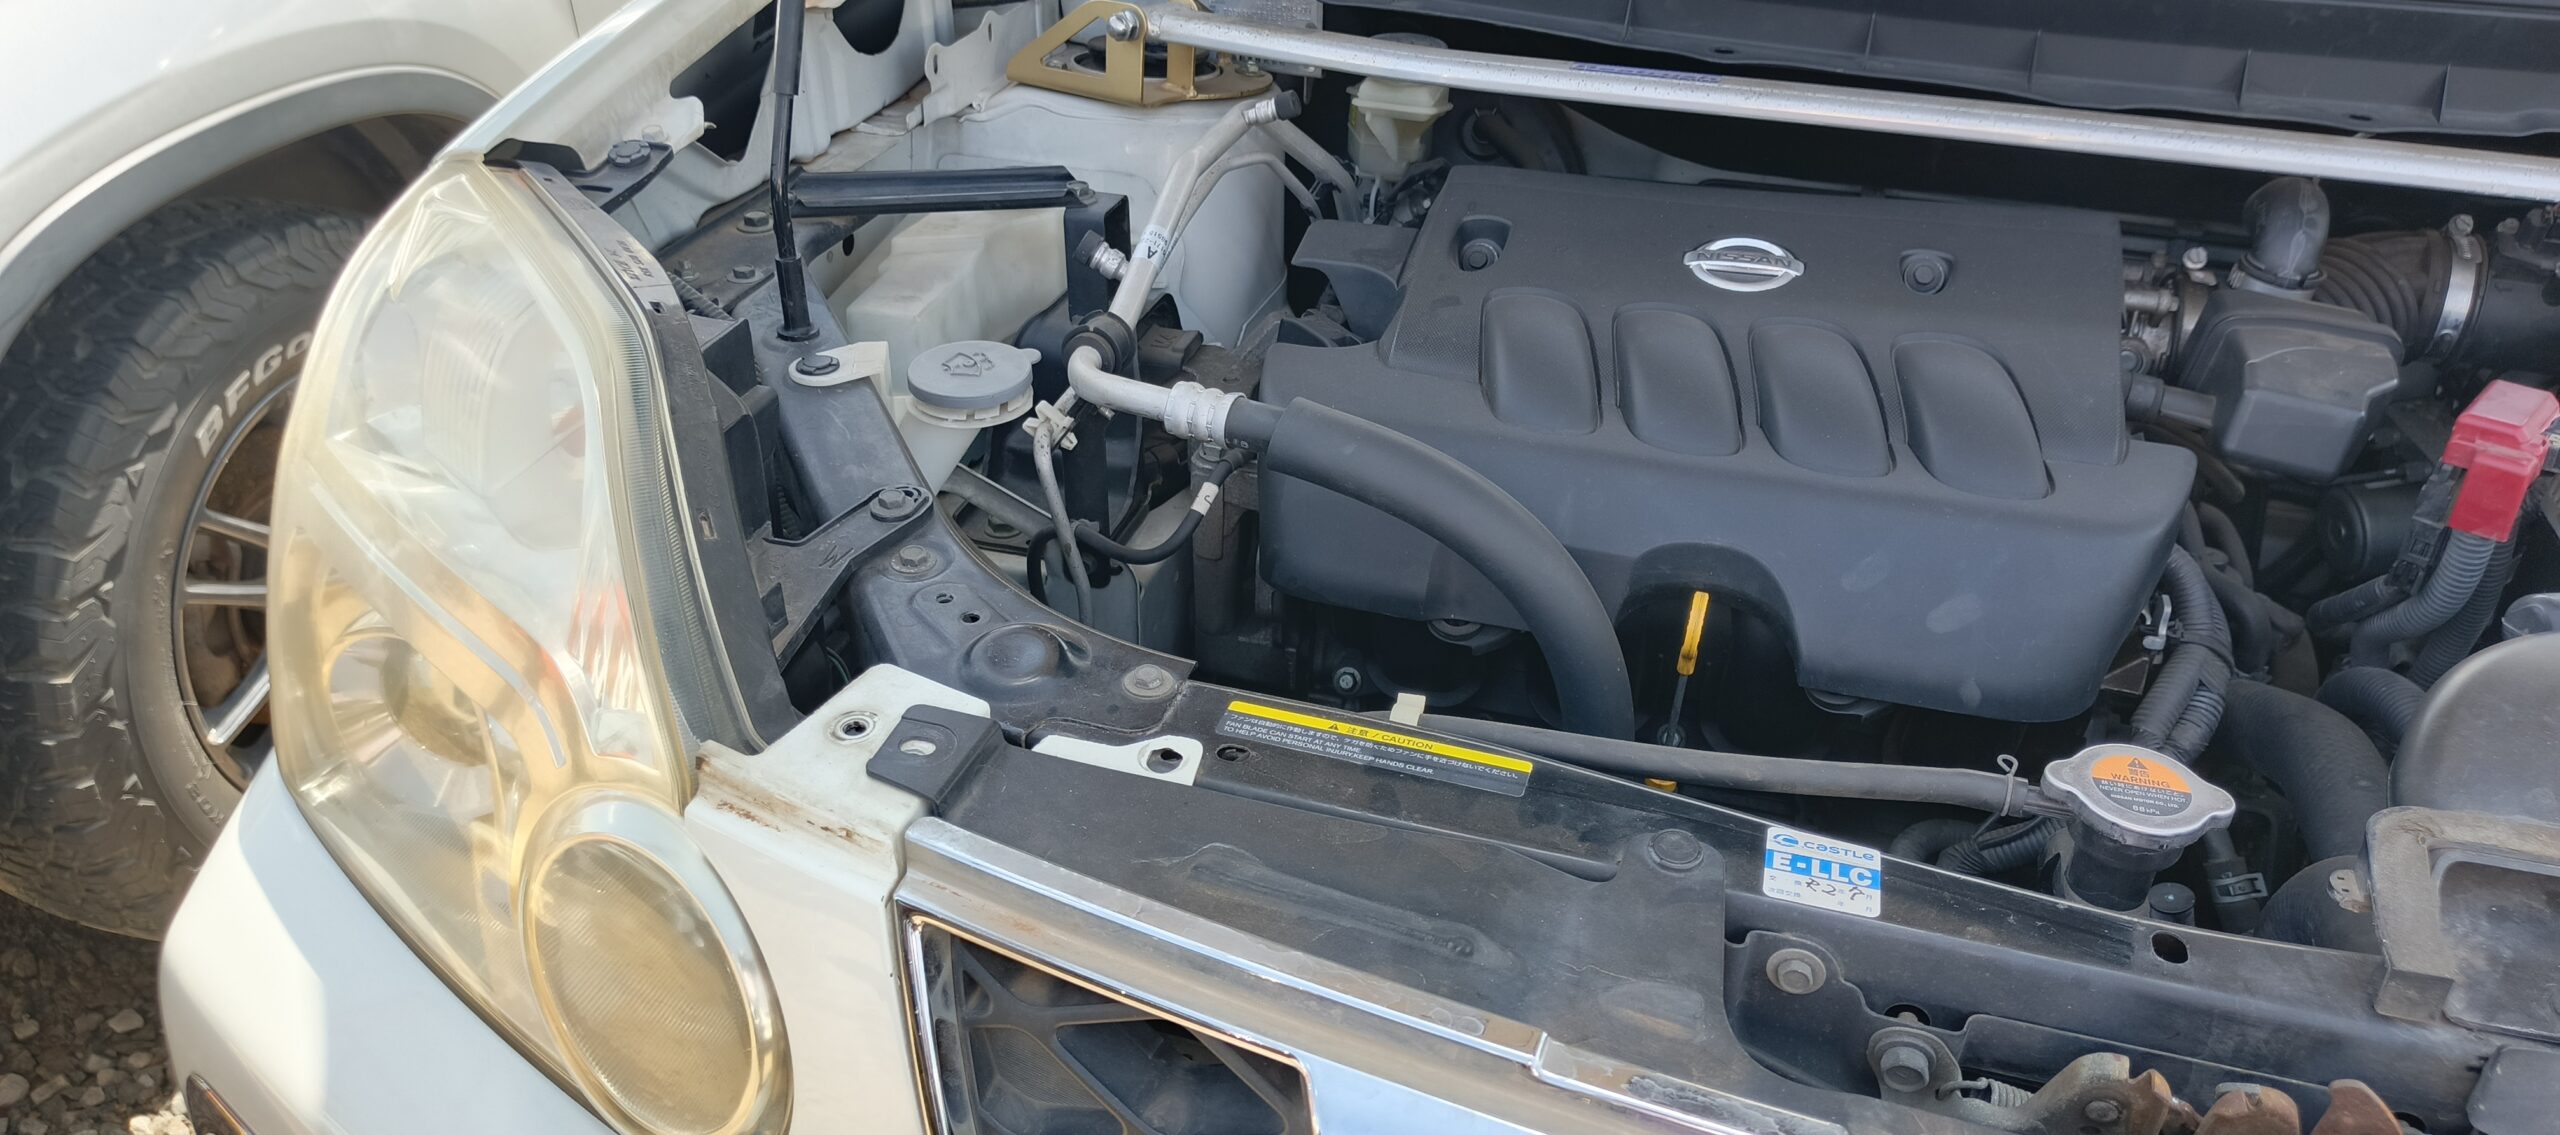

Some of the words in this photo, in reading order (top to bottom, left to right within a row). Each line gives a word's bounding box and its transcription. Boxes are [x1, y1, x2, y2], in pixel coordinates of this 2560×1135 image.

[1696, 251, 1792, 268] NISSAN
[1225, 720, 1241, 728] FAN
[1242, 723, 1268, 734] BLADE
[1269, 729, 1286, 737] CAN
[1287, 732, 1314, 743] START
[1324, 741, 1342, 749] ANY
[1346, 725, 1369, 737] 注意
[1381, 733, 1434, 750] CAUTION
[1235, 728, 1257, 736] HELP
[1256, 733, 1281, 742] AVOID
[1281, 737, 1324, 752] PERSONAL
[1375, 758, 1404, 768] HANDS
[1406, 764, 1435, 775] CLEAR.
[2099, 784, 2124, 793] NEVER
[2124, 788, 2146, 797] OPEN
[2147, 791, 2170, 801] WHEN
[2110, 772, 2171, 788] WARNING
[1772, 851, 1873, 887] E-LLC
